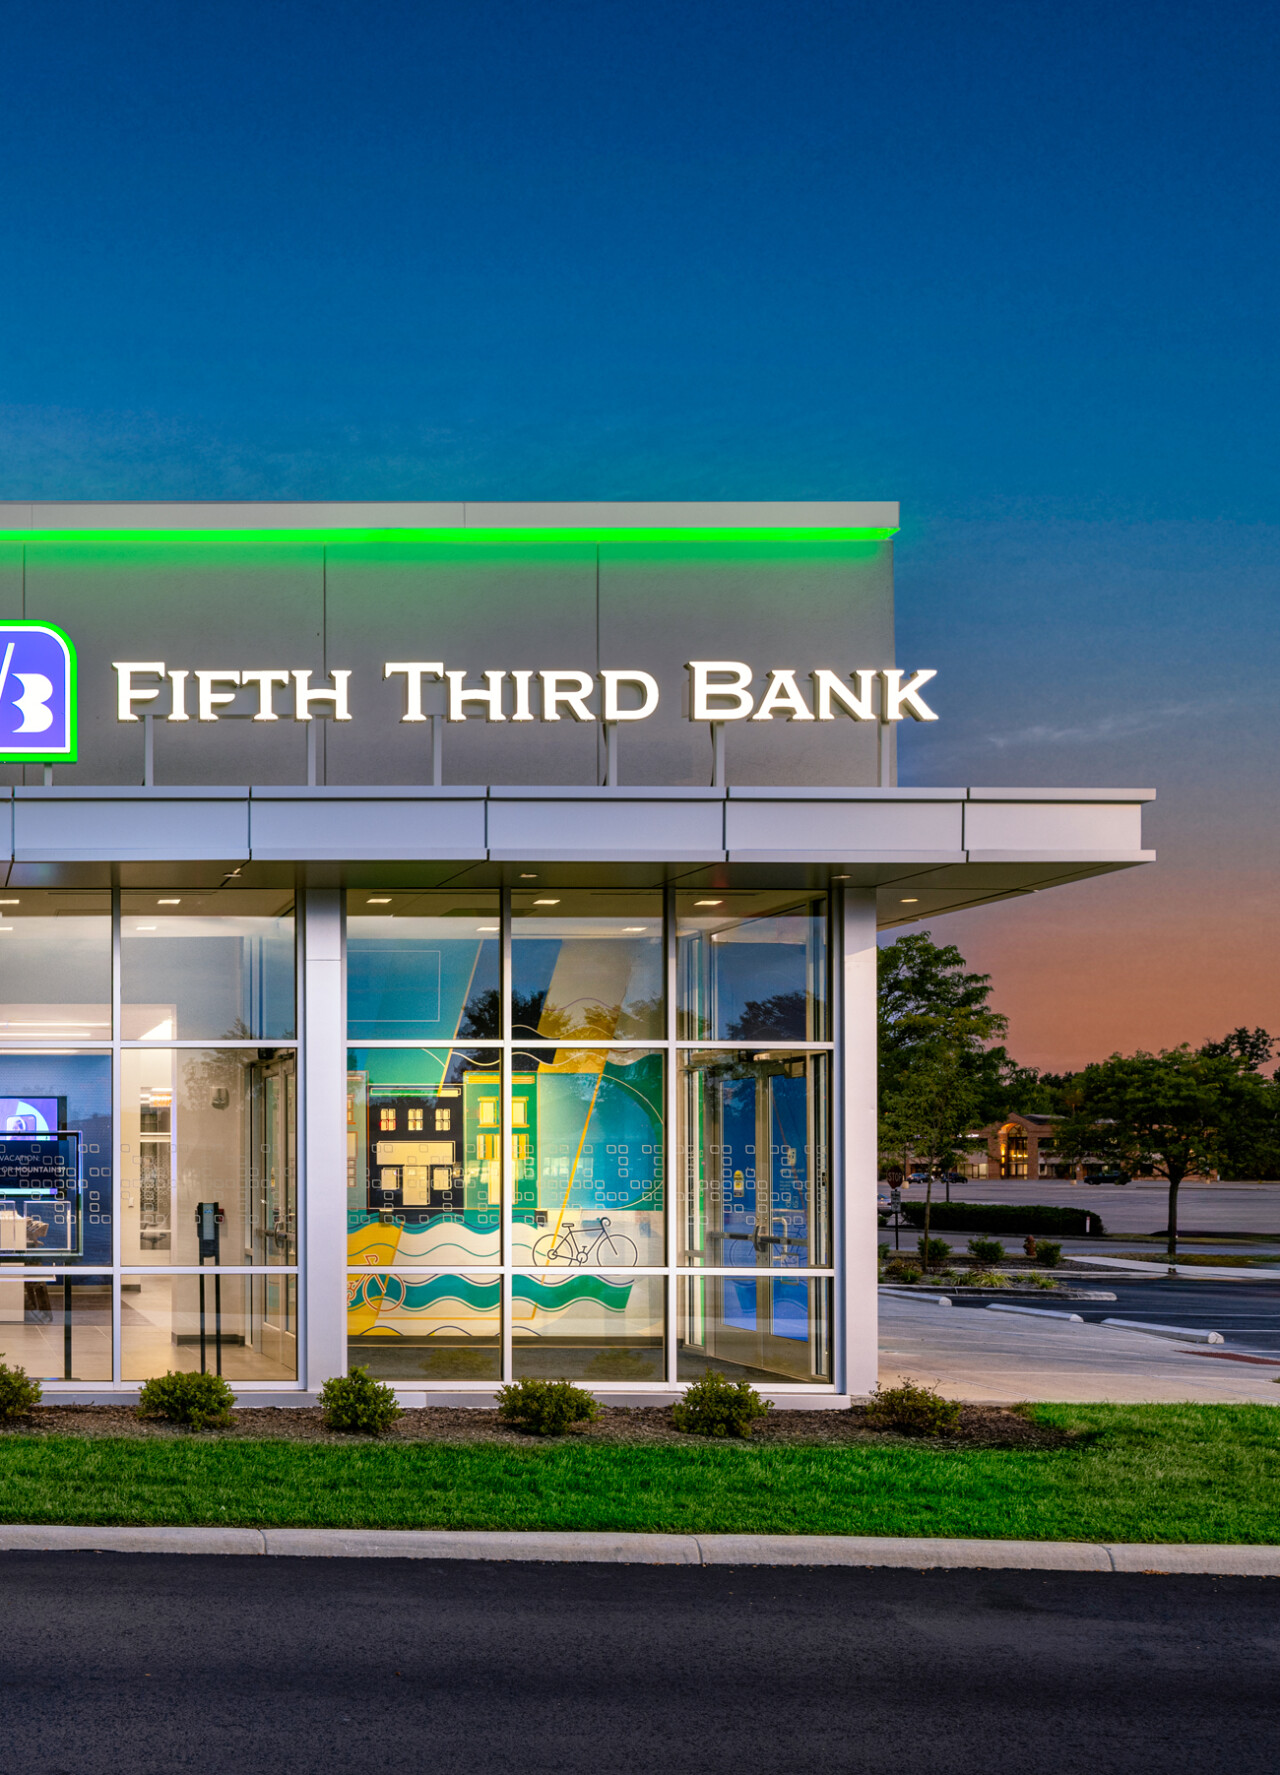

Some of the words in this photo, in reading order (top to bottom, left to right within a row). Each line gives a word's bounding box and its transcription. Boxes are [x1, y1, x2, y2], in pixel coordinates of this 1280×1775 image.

[111, 662, 352, 722] FIFTH
[383, 662, 659, 722] THIRD
[684, 660, 939, 722] BANK
[888, 1172, 902, 1182] STOP
